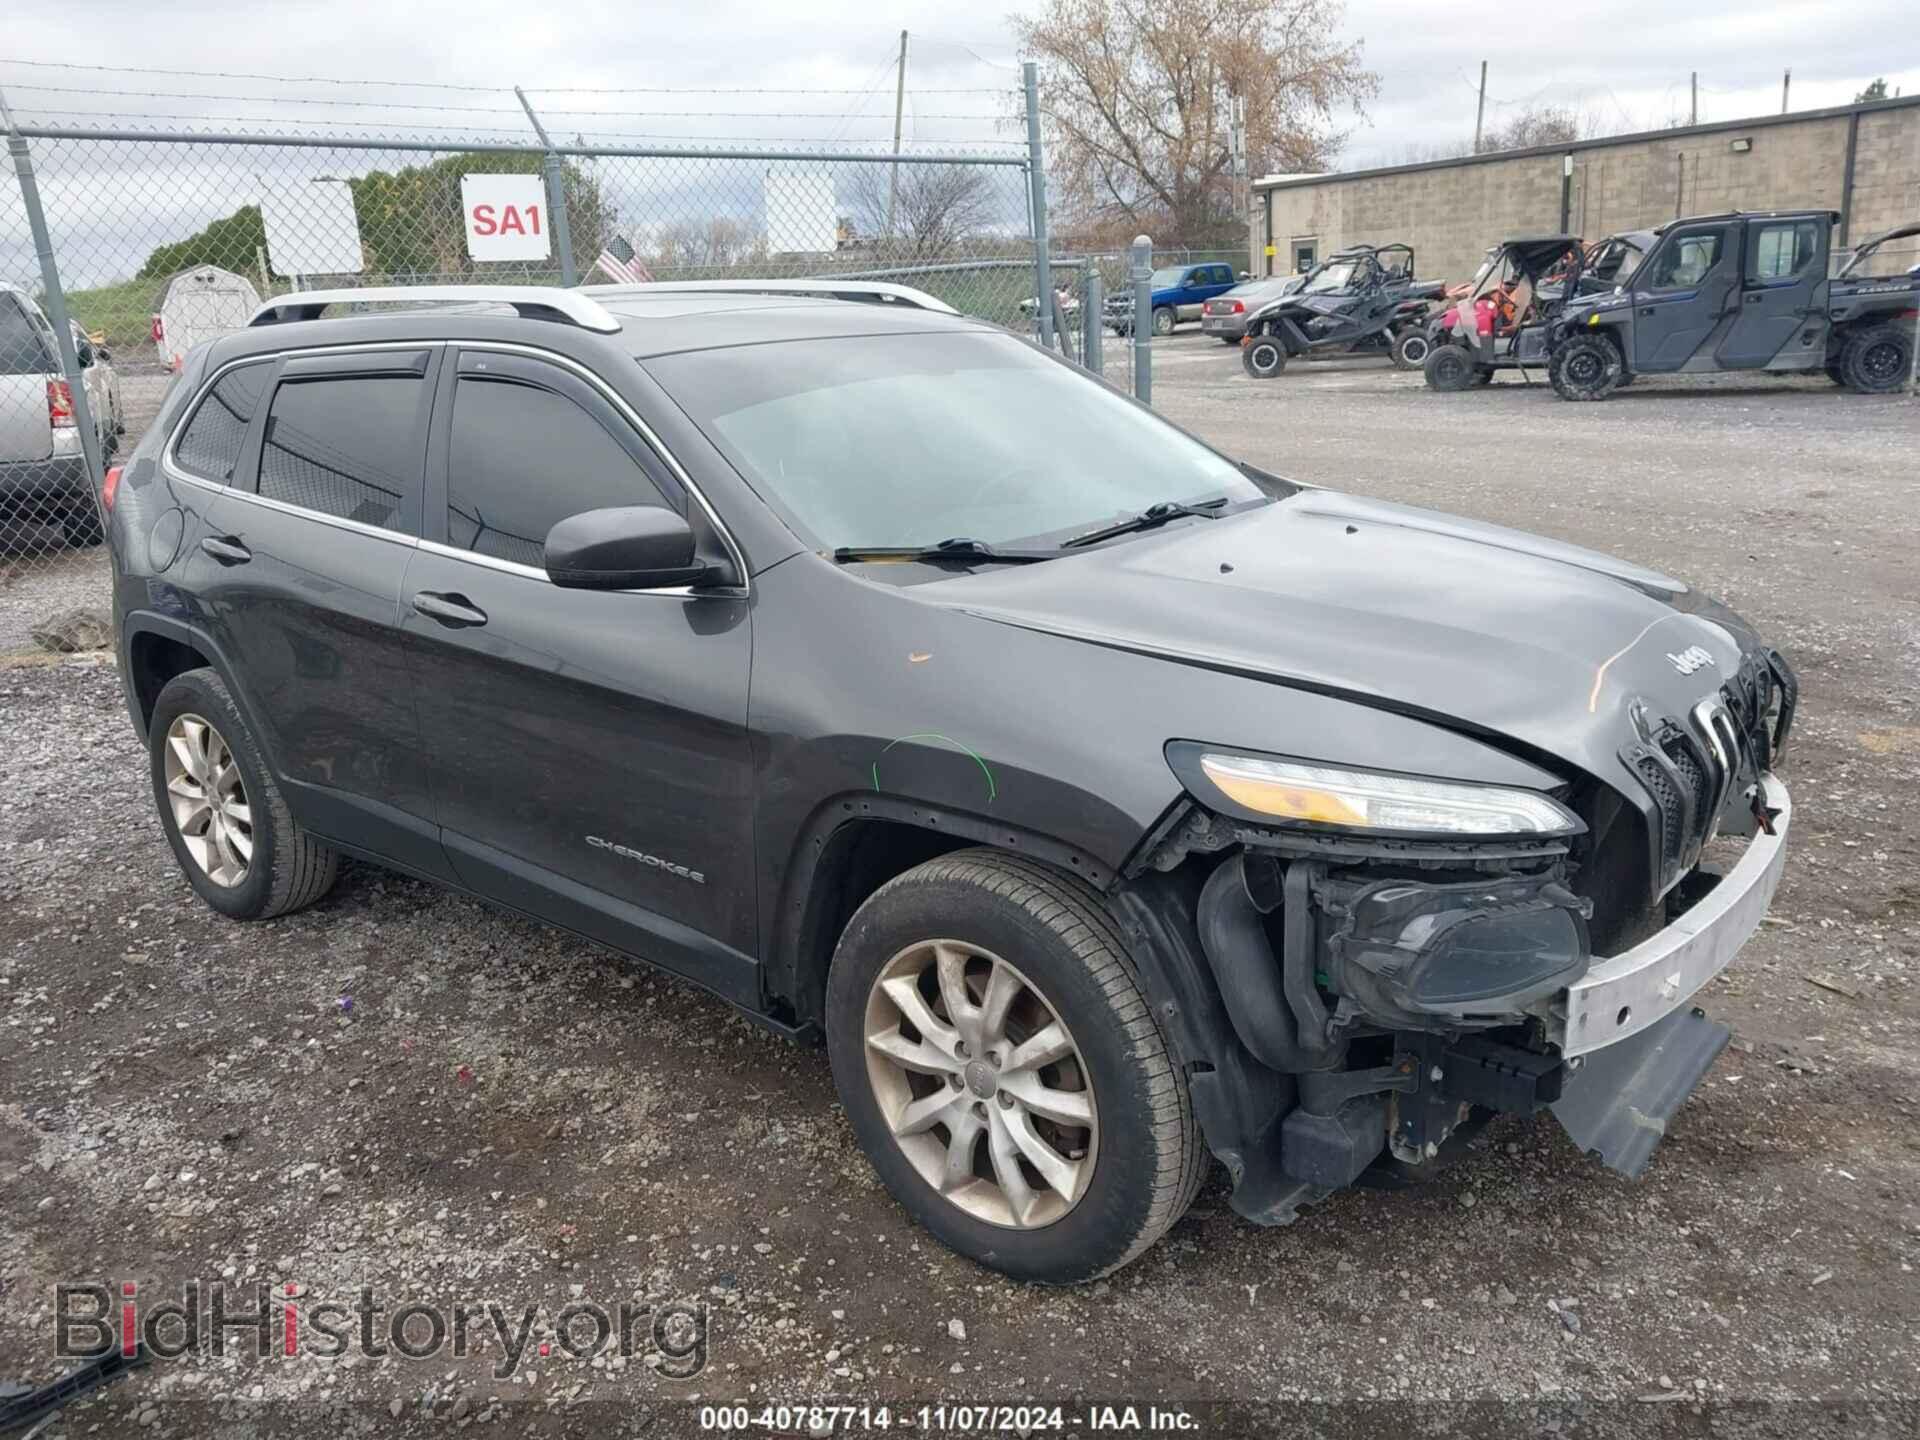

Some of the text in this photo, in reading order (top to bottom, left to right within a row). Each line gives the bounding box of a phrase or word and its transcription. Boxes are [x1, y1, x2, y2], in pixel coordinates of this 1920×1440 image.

[472, 204, 541, 236] SA1
[1666, 646, 1714, 674] Jeep
[585, 835, 705, 884] CHEROKEE
